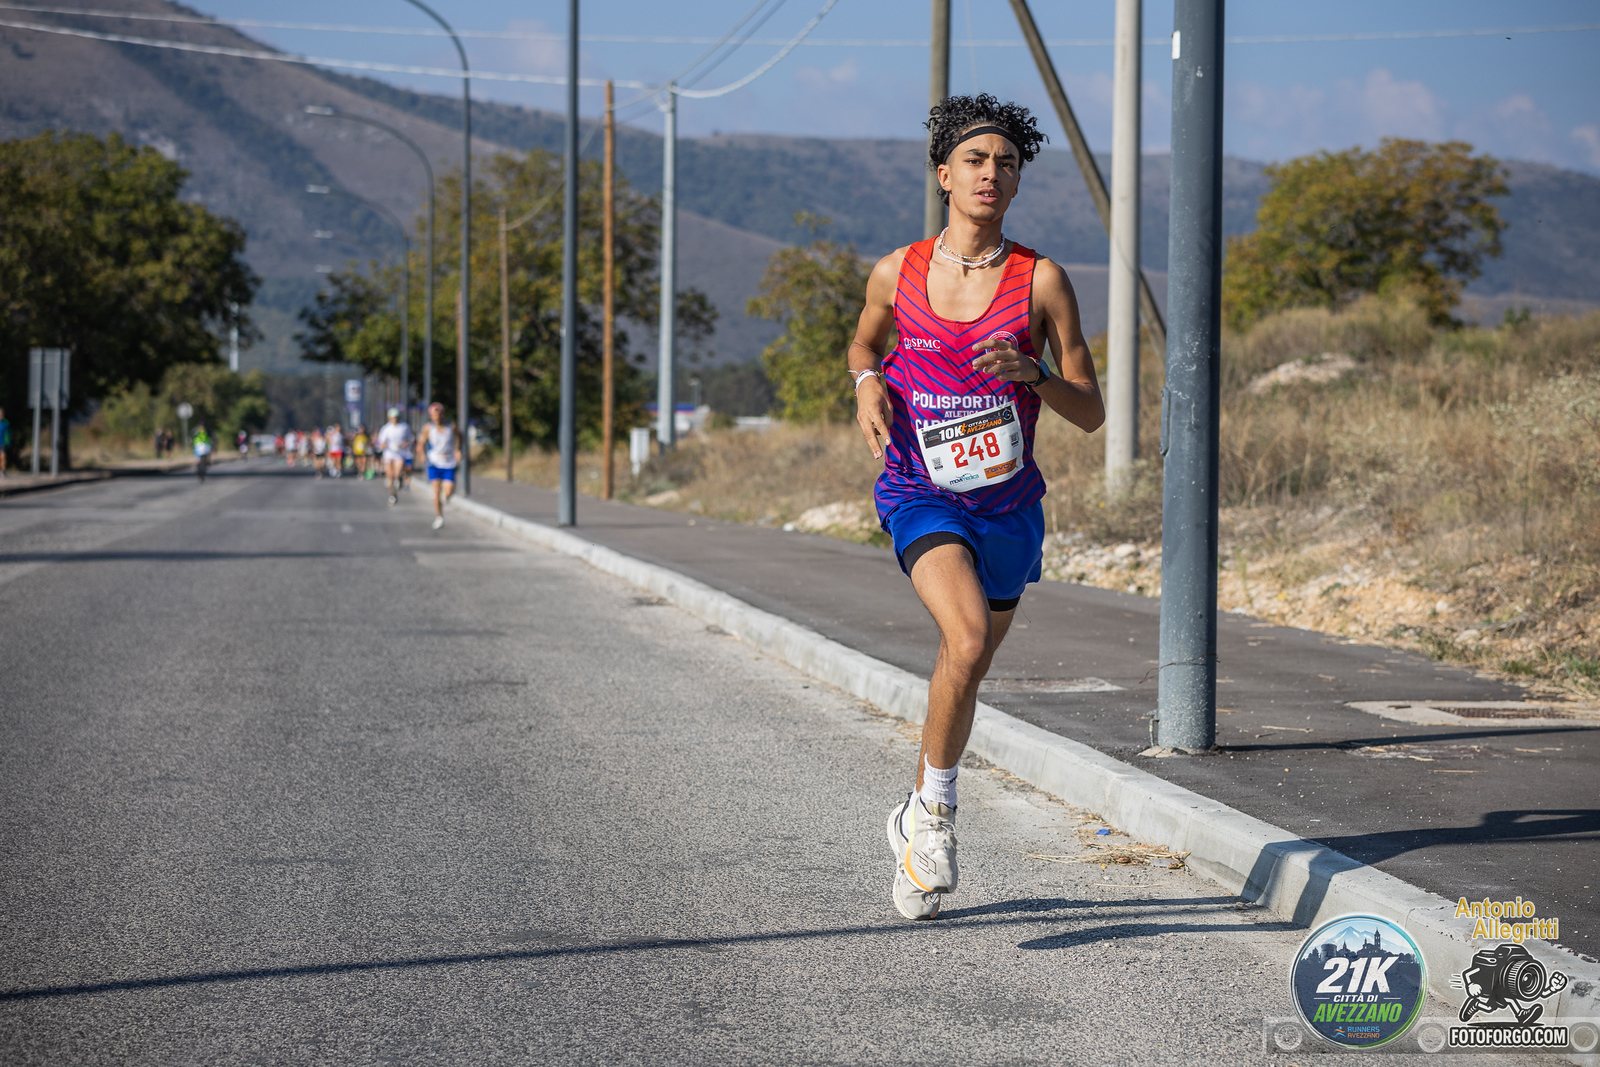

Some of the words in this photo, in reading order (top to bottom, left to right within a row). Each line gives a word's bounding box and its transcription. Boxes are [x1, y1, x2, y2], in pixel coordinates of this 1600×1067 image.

[911, 338, 941, 349] SPMC
[939, 425, 964, 441] 10K
[950, 431, 1001, 469] 248
